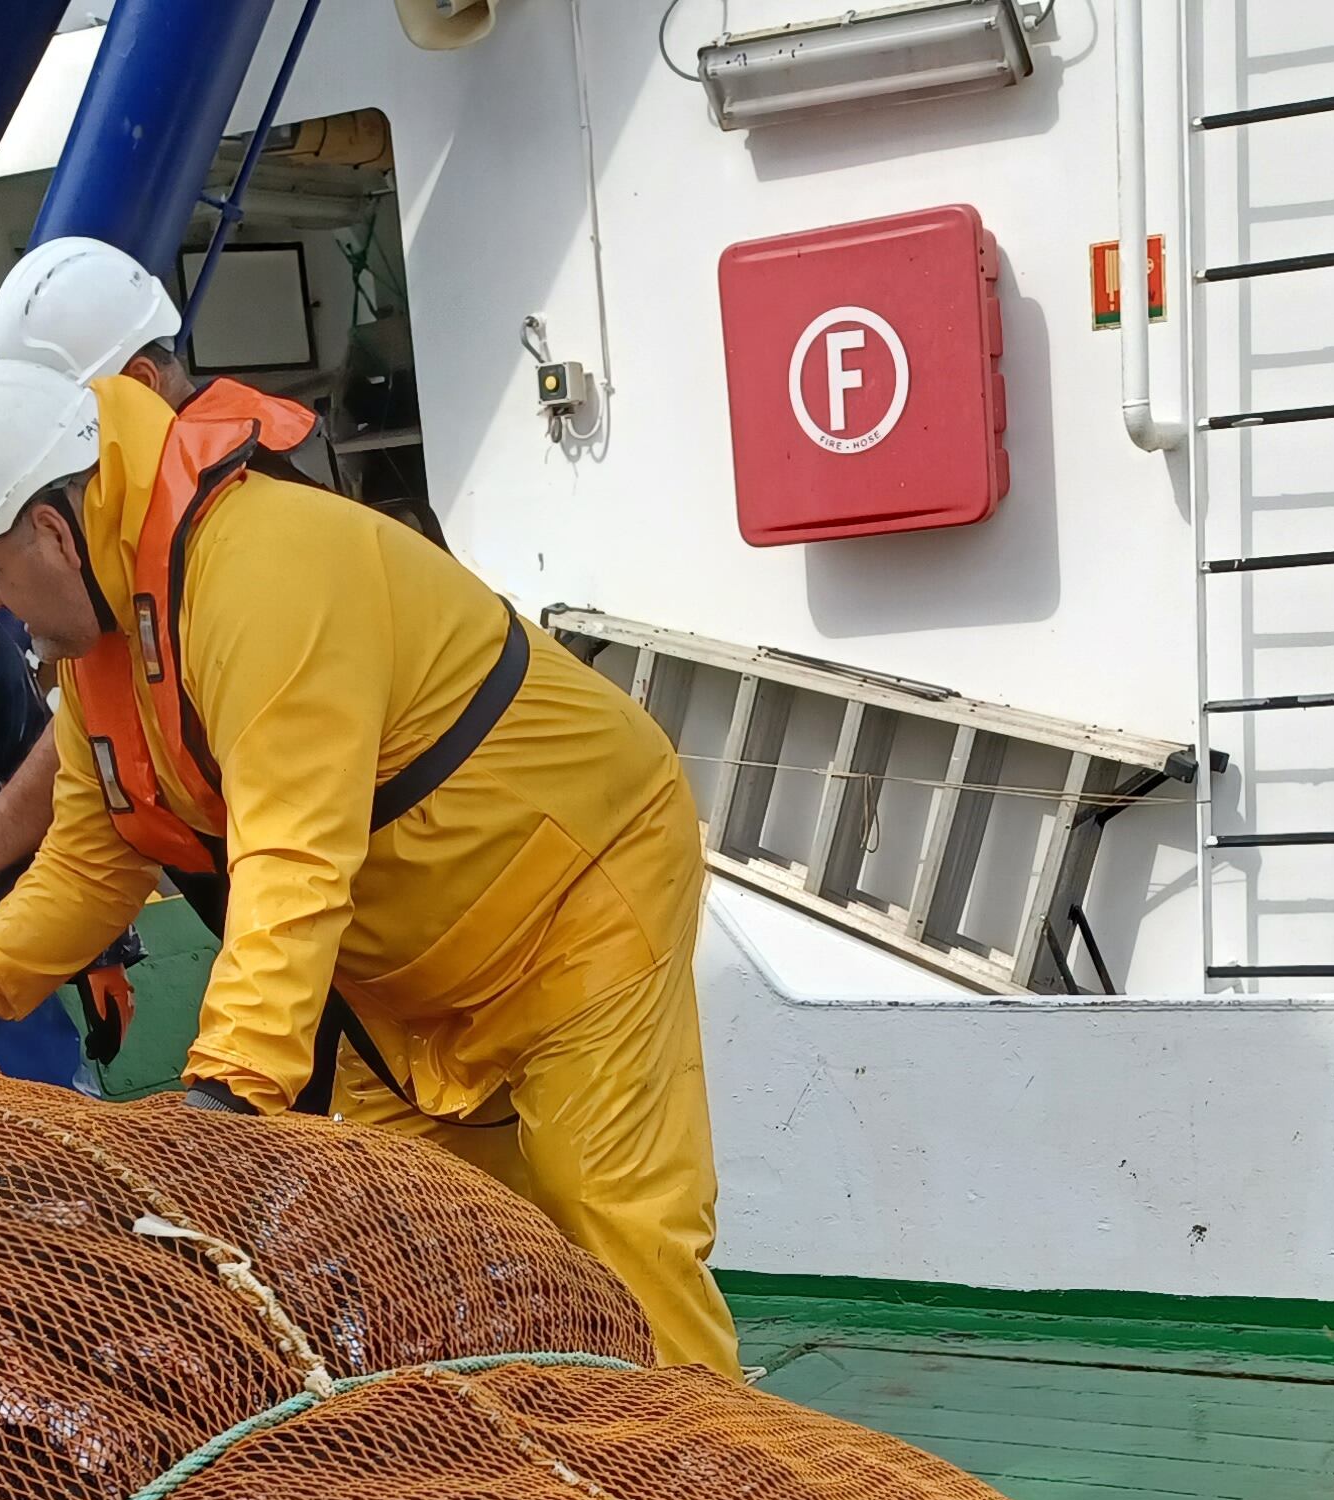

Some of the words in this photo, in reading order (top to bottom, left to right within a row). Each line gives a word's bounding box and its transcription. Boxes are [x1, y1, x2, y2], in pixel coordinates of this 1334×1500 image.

[826, 329, 865, 431] F
[819, 435, 842, 450] FIRE
[852, 430, 882, 449] HOSE
